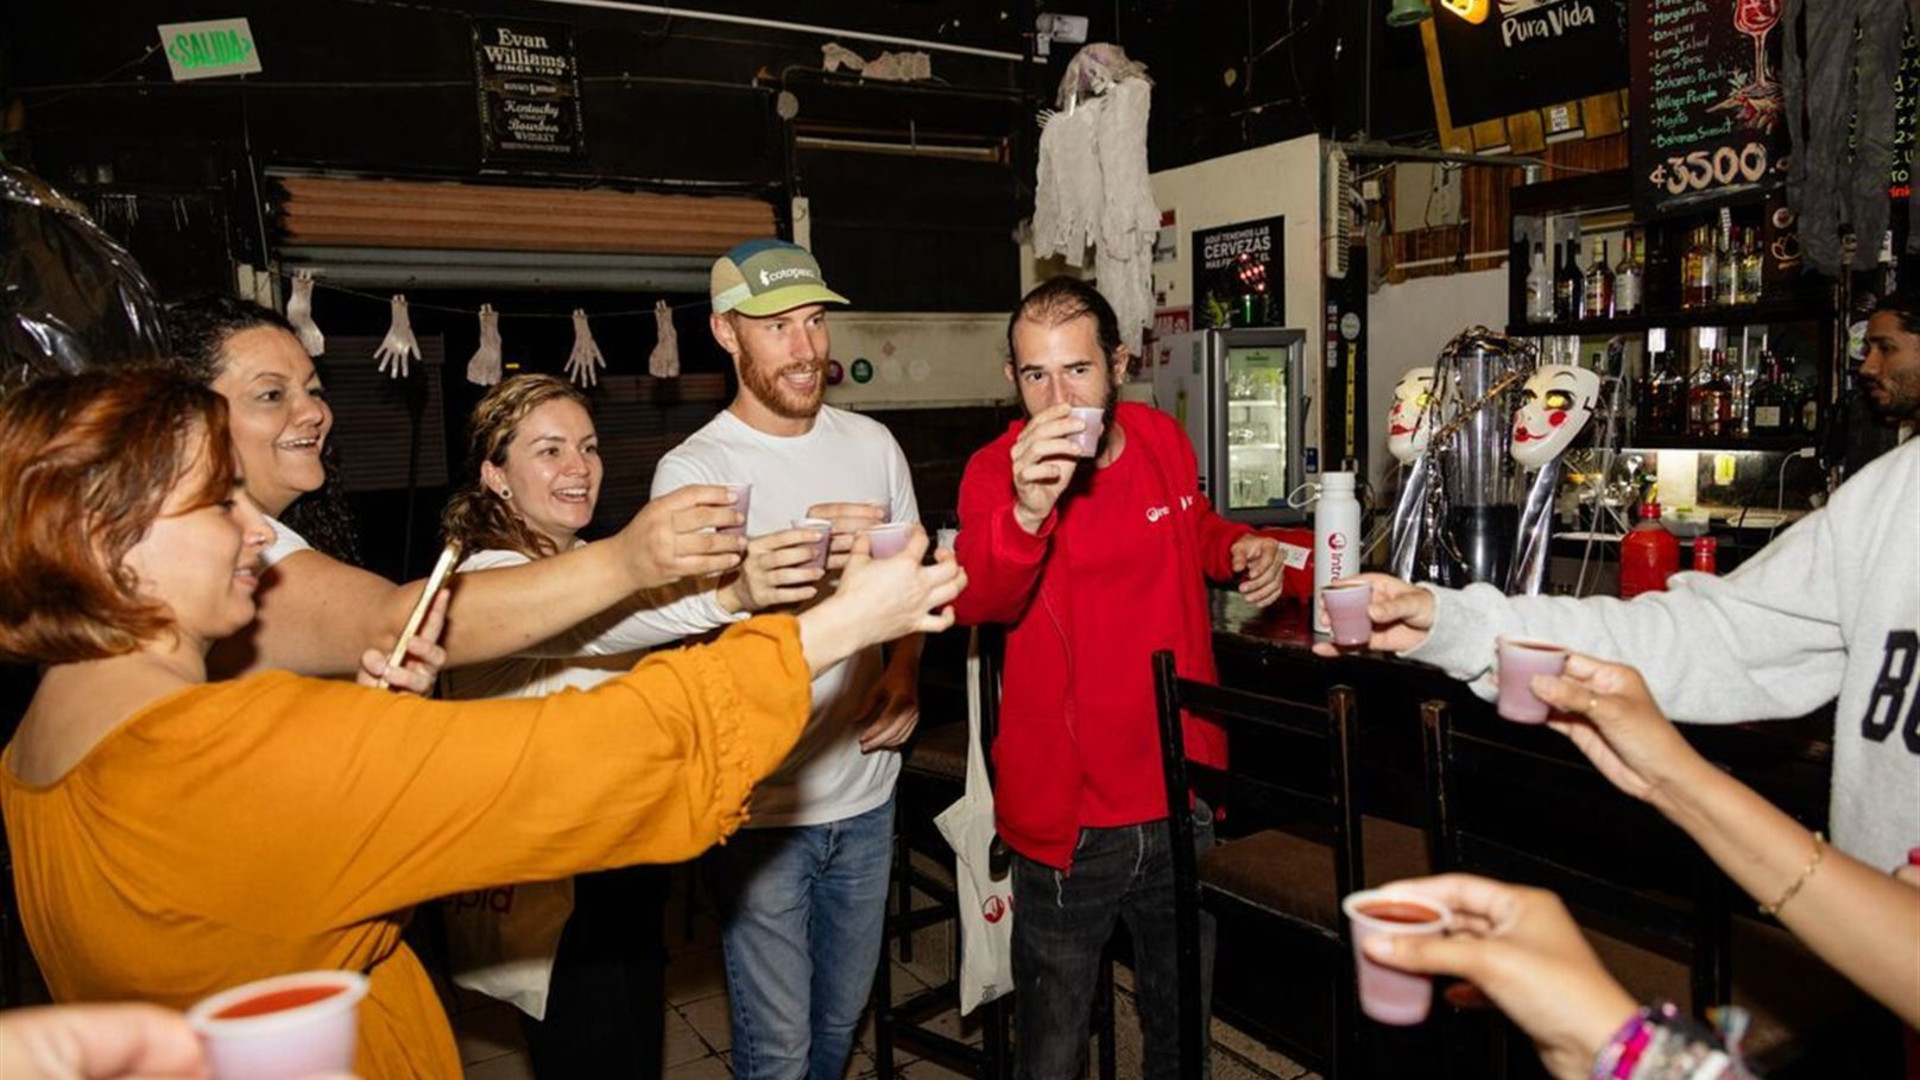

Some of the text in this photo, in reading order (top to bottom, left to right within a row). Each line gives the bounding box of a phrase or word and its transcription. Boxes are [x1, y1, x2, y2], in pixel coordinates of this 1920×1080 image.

[1501, 1, 1595, 47] Pura Vida
[1654, 2, 1708, 26] Margarita
[175, 29, 248, 68] SALIDA
[497, 27, 549, 49] Evan
[484, 45, 567, 69] Williams
[504, 100, 559, 119] Kentucky
[508, 118, 559, 133] Bourbon
[1222, 228, 1254, 242] TENEMOS
[1255, 225, 1270, 237] LAS
[1204, 236, 1271, 259] CERVEZAS
